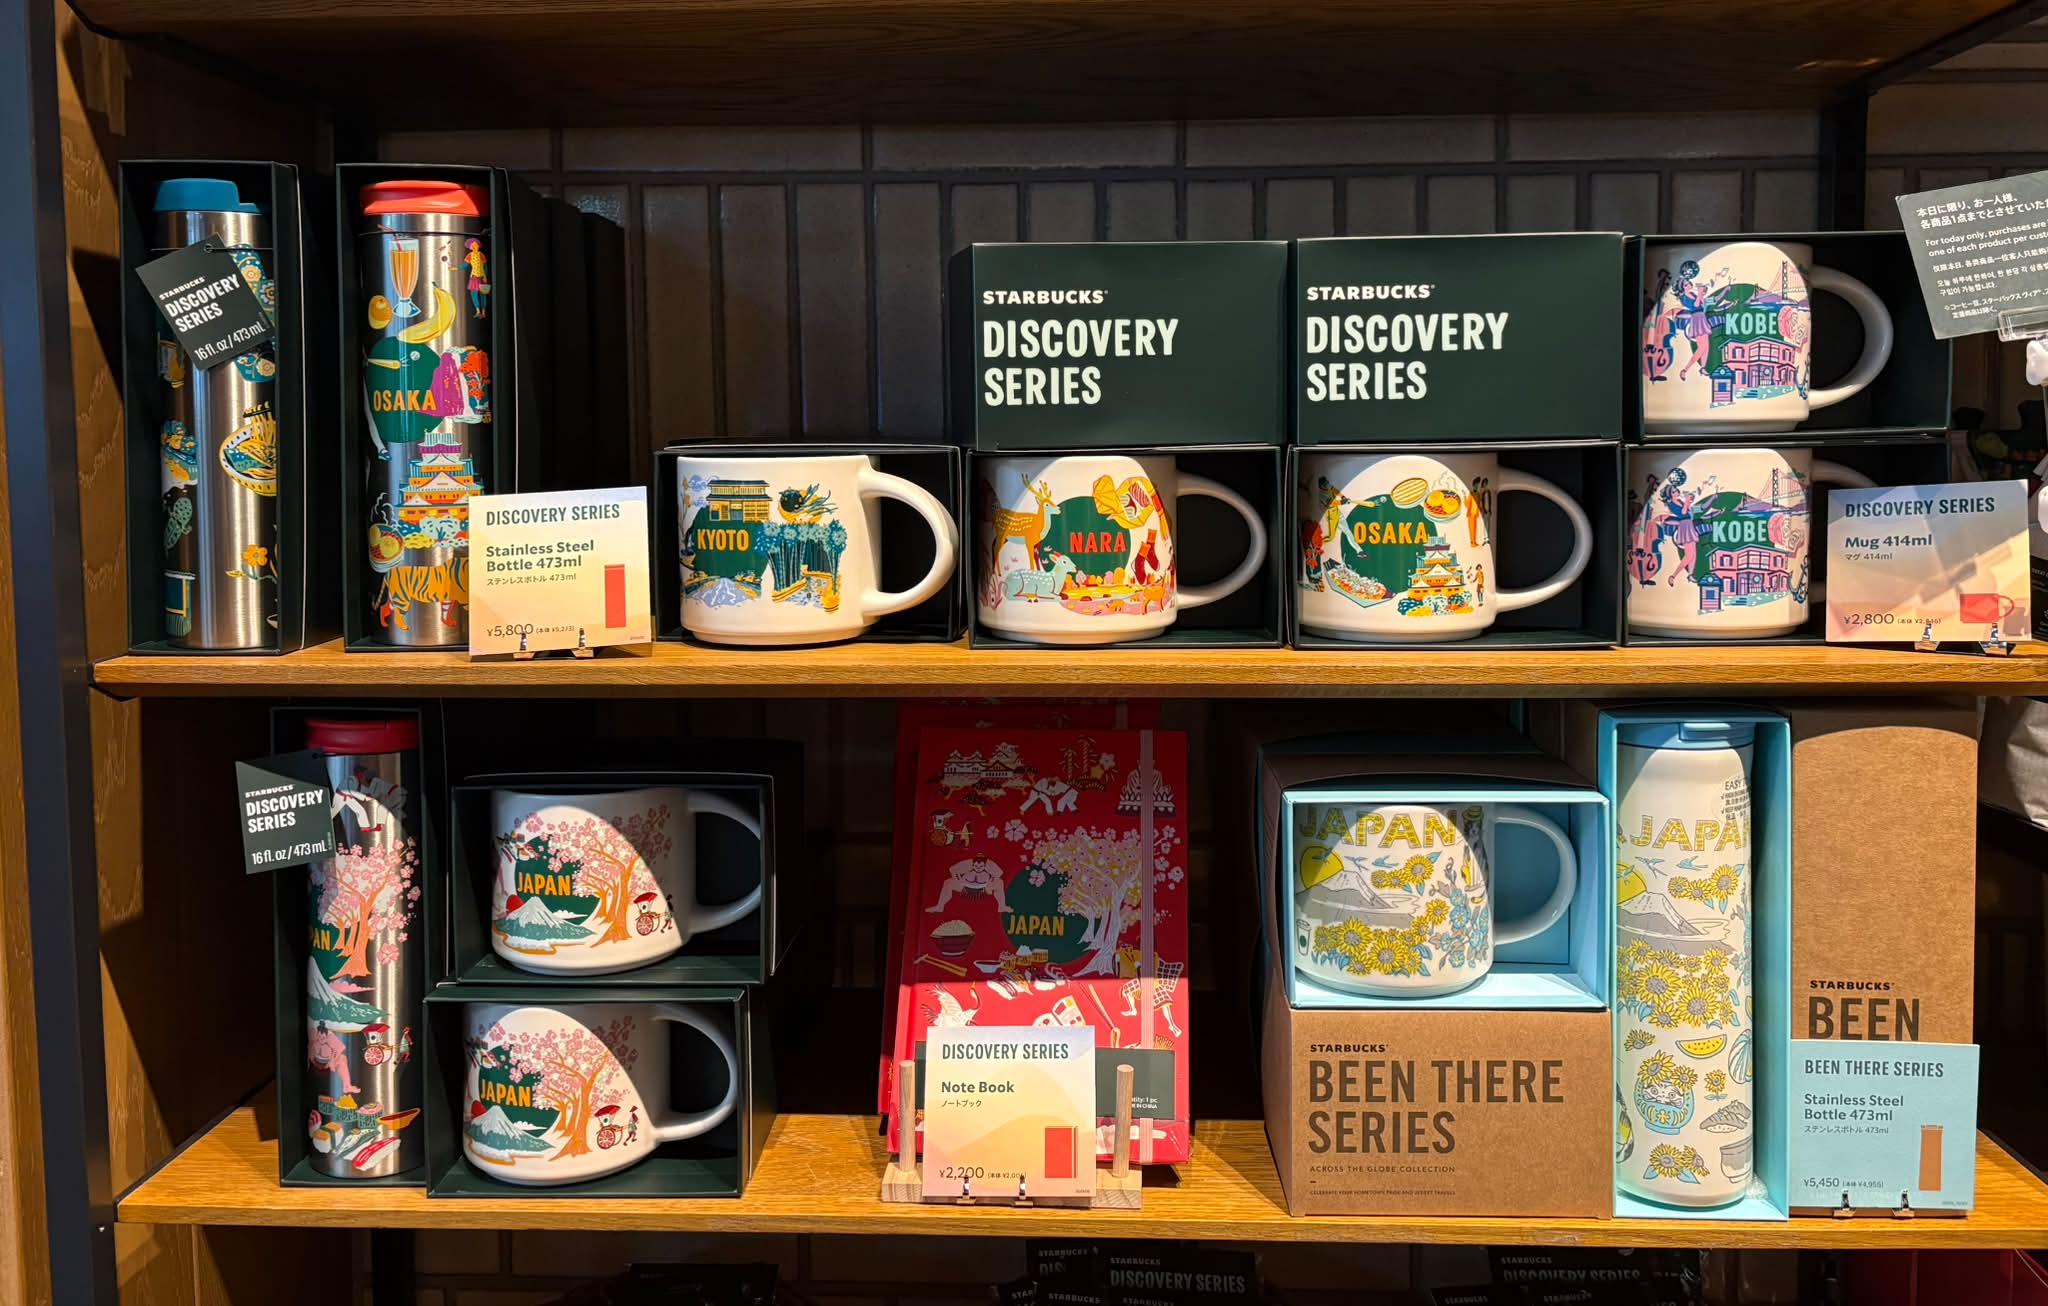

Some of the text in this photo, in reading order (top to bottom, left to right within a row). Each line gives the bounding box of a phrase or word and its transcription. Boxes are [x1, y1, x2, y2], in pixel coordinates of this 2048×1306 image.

[1925, 239, 1939, 247] For
[1940, 235, 1965, 244] today
[1988, 224, 2031, 238] purchases
[1928, 249, 1945, 257] one
[1946, 246, 1955, 254] of
[1957, 243, 1977, 252] each
[1978, 237, 2012, 250] product
[2013, 235, 2028, 245] per
[159, 276, 205, 300] STARBUCKS
[165, 274, 241, 317] DISCOVERY
[982, 289, 1105, 306] STARBUCKS
[1306, 284, 1431, 301] STARBUCKS
[175, 302, 224, 333] SERIES
[1724, 310, 1778, 336] KOBE
[982, 318, 1179, 359] DISCOVERY
[1306, 312, 1509, 354] DISCOVERY
[983, 366, 1102, 407] SERIES
[1306, 360, 1427, 402] SERIES
[373, 389, 437, 412] OSAKA
[486, 503, 620, 526] DISCOVERY SERIES
[1845, 497, 1995, 518] DISCOVERY SERIES
[696, 527, 750, 552] KYOTO
[1353, 520, 1429, 545] OSAKA
[1711, 518, 1768, 543] KOBE
[486, 539, 595, 558] Stainless Steel
[1069, 530, 1128, 554] NARA
[1844, 534, 1932, 550] Mug 414ml
[486, 555, 582, 572] Bottle 473ml
[1845, 552, 1893, 561] マグ 414ml
[487, 573, 577, 586] ステンレスボトル 473ml
[486, 623, 534, 638] ¥5,800
[1843, 613, 1895, 626] ¥2,800
[244, 784, 294, 799] STARBUCKS
[245, 789, 324, 817] DISCOVERY
[248, 811, 296, 834] SERIES
[1299, 805, 1457, 848] JAPAN
[517, 872, 571, 896] JAPAN
[1007, 914, 1065, 937] JAPAN
[1810, 980, 1890, 991] STARBUCKS
[1808, 996, 1920, 1042] BEEN
[942, 1043, 1069, 1060] DISCOVERY SERIES
[1310, 1043, 1386, 1053] STARBUCKS
[1804, 1059, 1944, 1078] BEEN THERE SERIES
[480, 1077, 532, 1108] JAPAN
[941, 1080, 1015, 1094] Note Book
[1308, 1059, 1565, 1104] BEEN THERE
[941, 1099, 982, 1108] ノートブック
[1804, 1093, 1904, 1107] Stainless Steel
[1804, 1108, 1893, 1121] Bottle 473ml
[1308, 1110, 1456, 1154] SERIES
[1804, 1125, 1889, 1134] ステンレスボトル 473ml
[939, 1166, 985, 1181] ¥2,200
[1310, 1165, 1456, 1173] ACROSS THE GLOBE COLLECTION
[1803, 1177, 1840, 1189] ¥5,450
[1110, 1257, 1161, 1266] STARBUCKS
[1110, 1269, 1246, 1294] DISCOVERY SERIES
